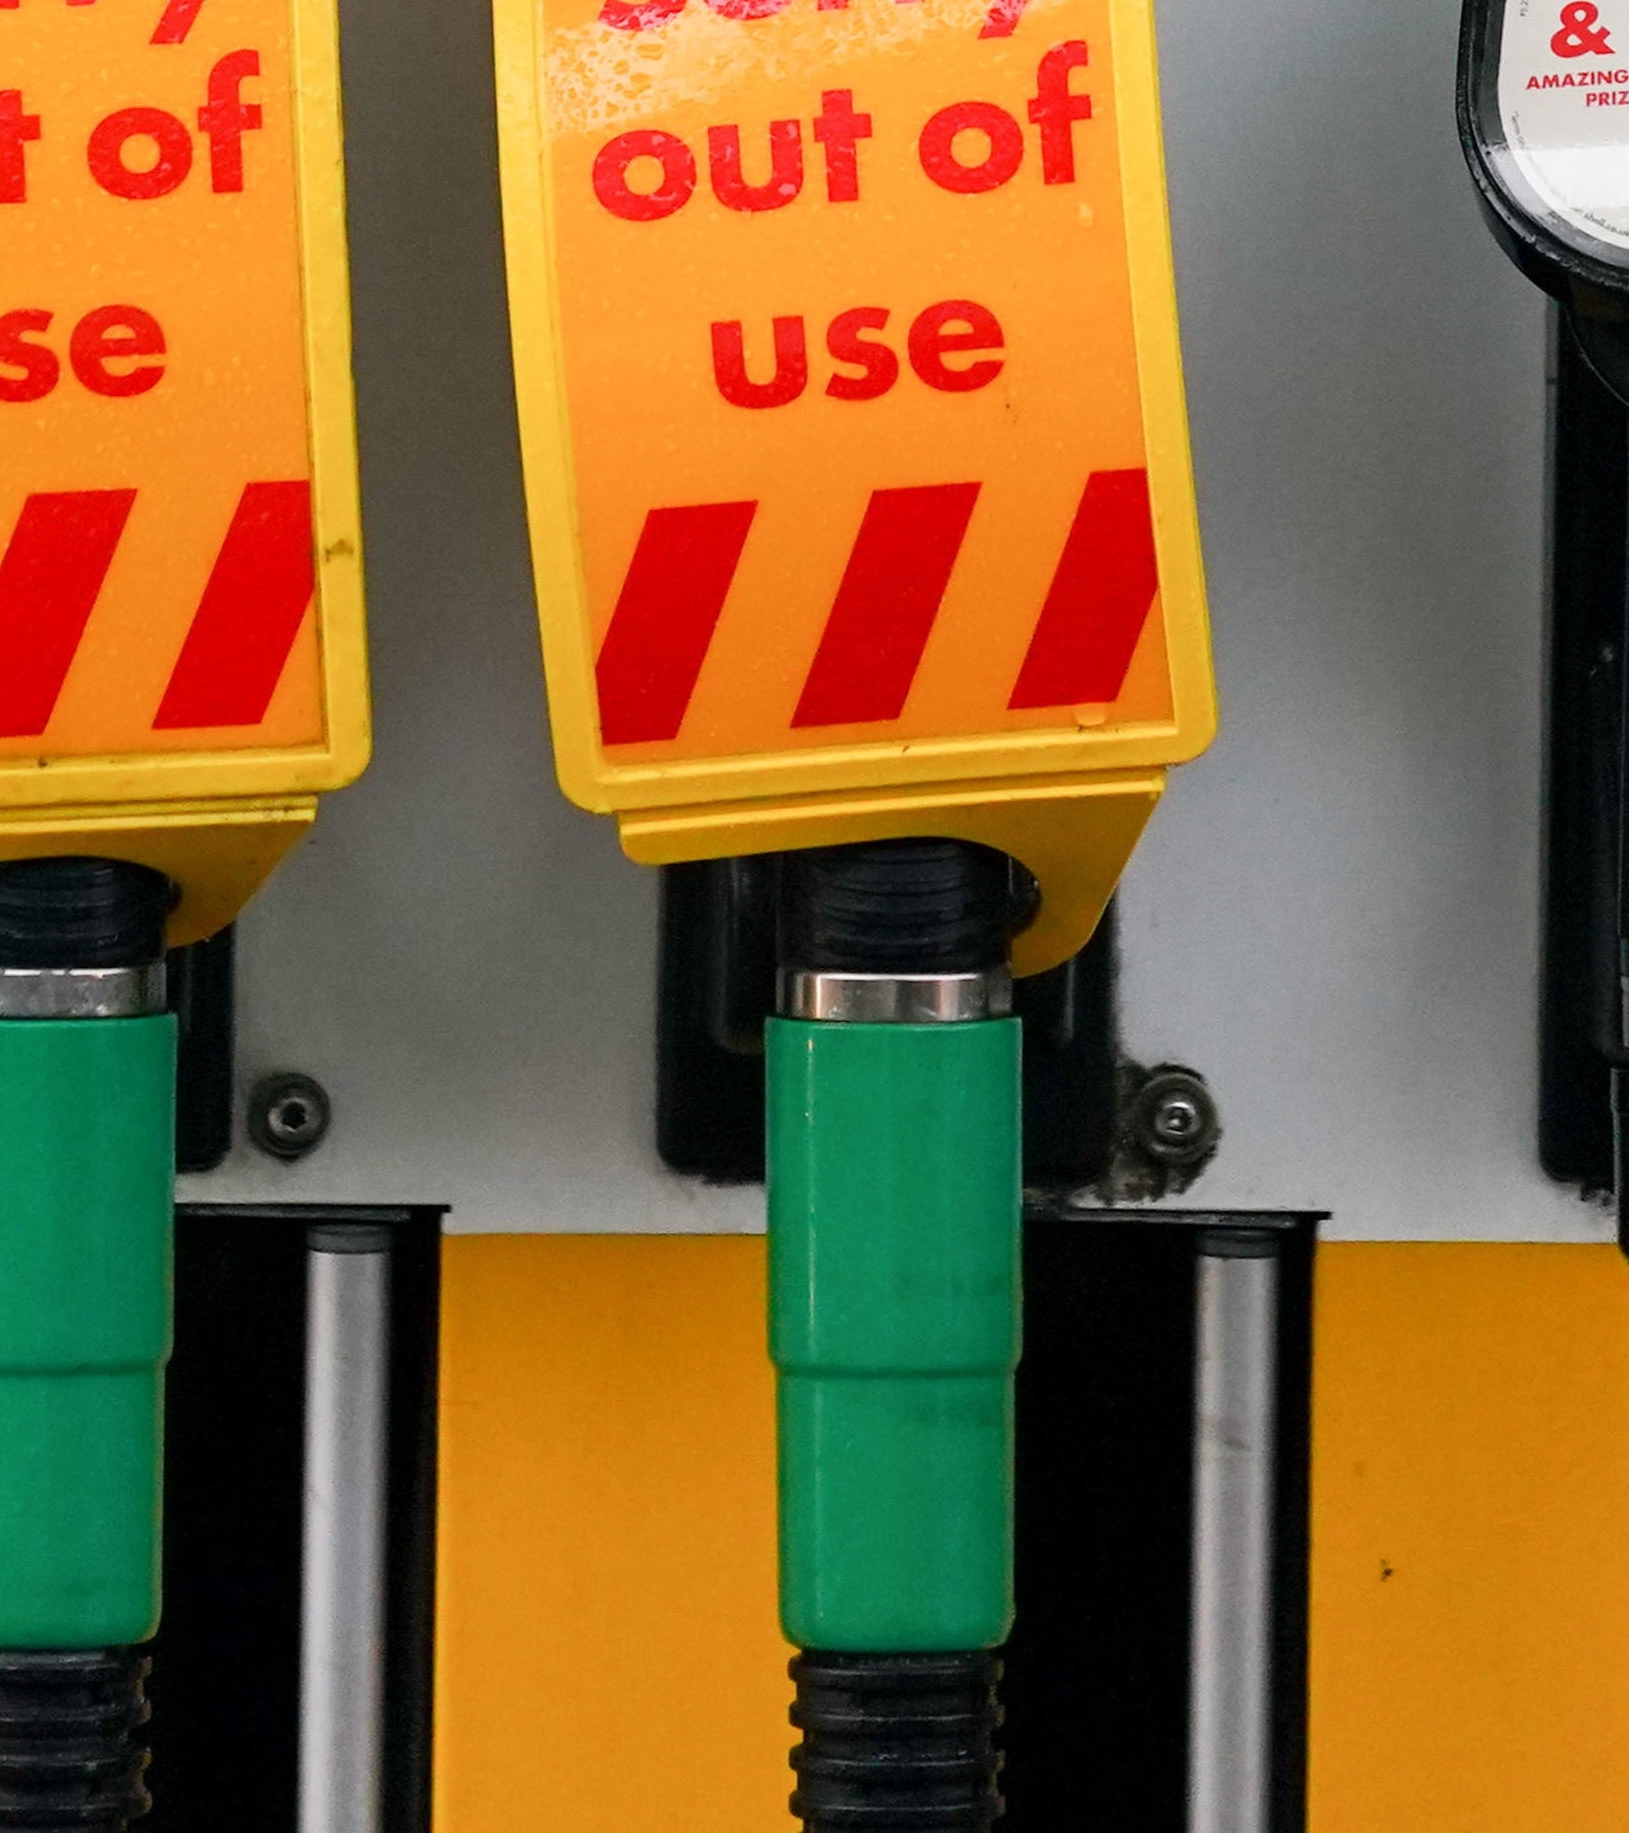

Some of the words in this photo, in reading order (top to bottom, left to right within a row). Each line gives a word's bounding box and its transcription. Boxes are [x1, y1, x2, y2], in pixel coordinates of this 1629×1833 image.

[1525, 69, 1629, 90] AMAZING
[1550, 1, 1615, 59] &
[86, 49, 263, 201] of
[591, 89, 873, 222] out
[918, 40, 1093, 194] of
[710, 299, 1006, 410] use
